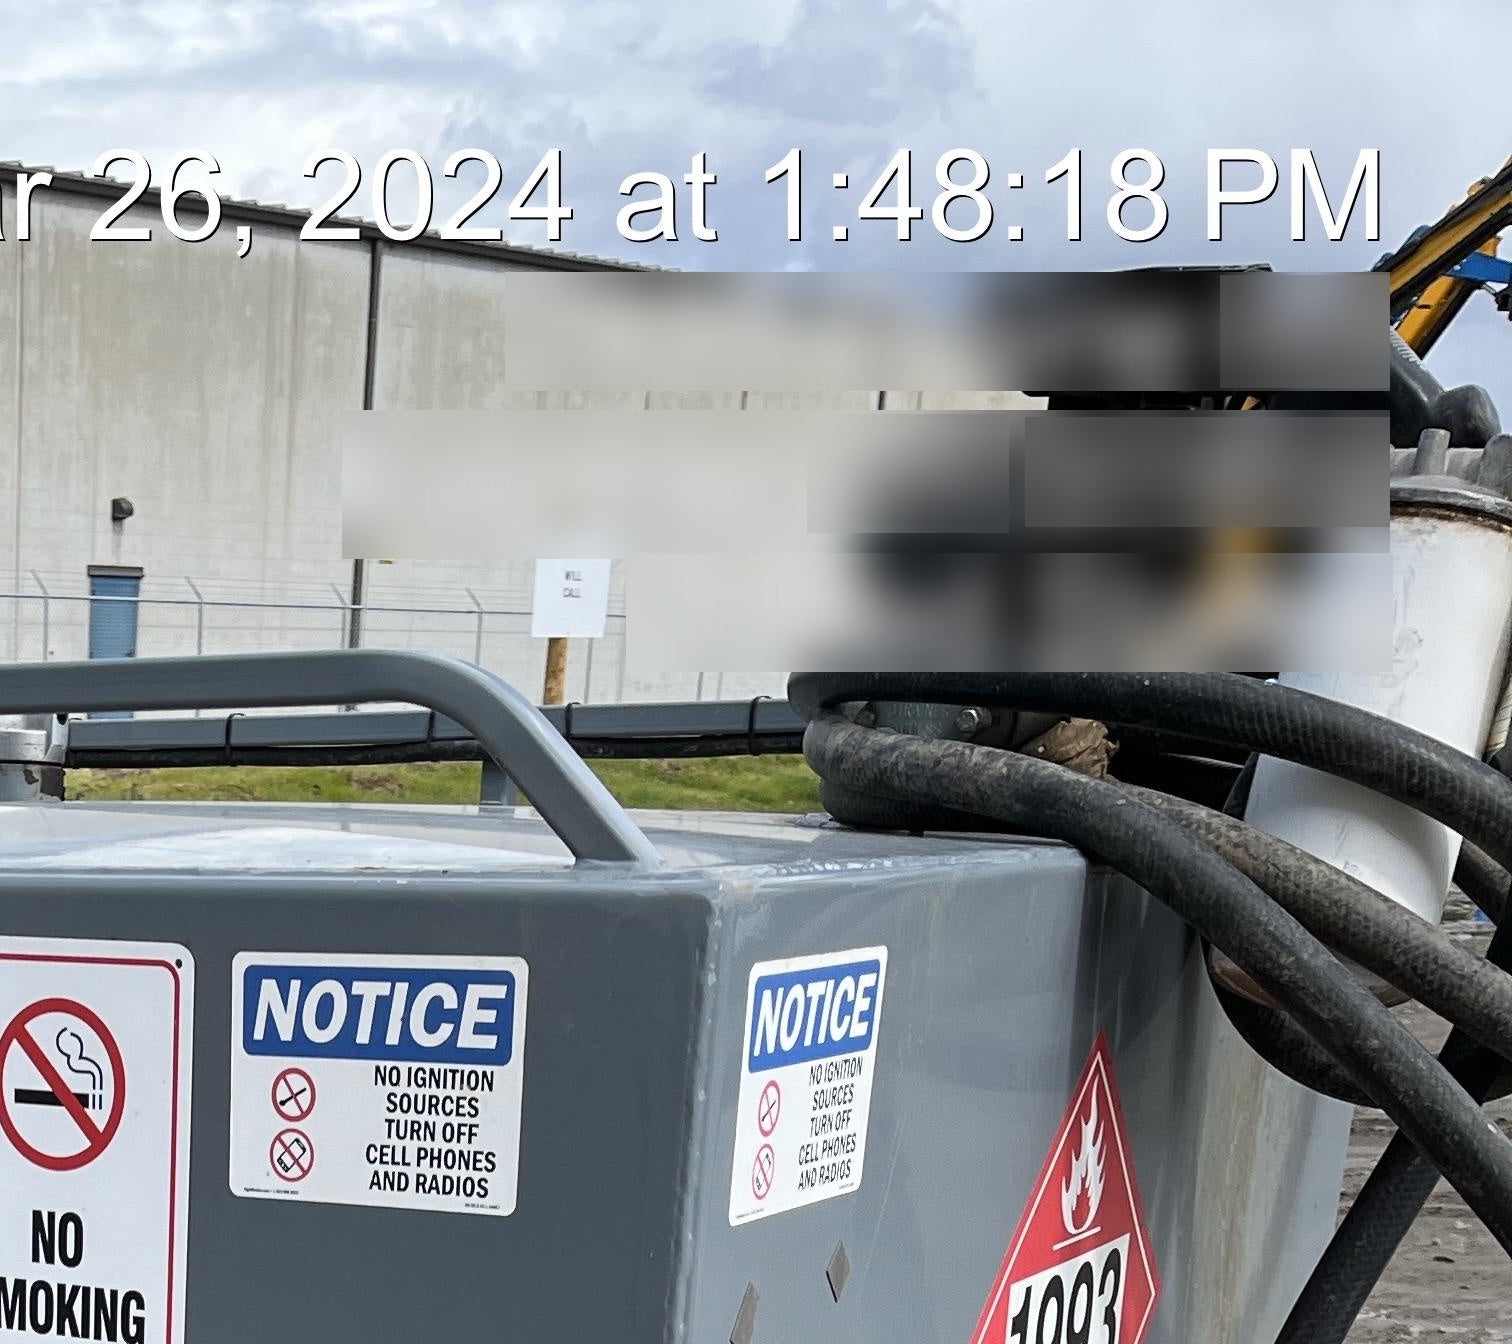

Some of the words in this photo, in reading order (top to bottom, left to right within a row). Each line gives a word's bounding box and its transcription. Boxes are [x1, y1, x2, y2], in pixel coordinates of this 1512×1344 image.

[253, 977, 509, 1051] NOTICE
[753, 972, 878, 1057] NOTICE
[374, 1064, 401, 1088] NO
[406, 1066, 495, 1092] IGNITION
[808, 1064, 824, 1086] NO
[824, 1056, 863, 1084] IGNITION
[386, 1091, 480, 1118] SOURCES
[812, 1083, 854, 1111] SOURCES
[384, 1118, 436, 1143] TURN
[442, 1122, 480, 1144] OFF
[810, 1113, 834, 1138] TURN
[834, 1109, 853, 1131] OFF
[365, 1143, 411, 1167] CELL
[416, 1147, 497, 1173] PHONES
[798, 1140, 819, 1166] CELL
[821, 1132, 857, 1160] PHONES
[369, 1170, 410, 1192] AND
[415, 1173, 489, 1199] RADIOS
[798, 1166, 818, 1191] AND
[818, 1158, 852, 1184] RADIOS
[30, 1209, 84, 1268] NO
